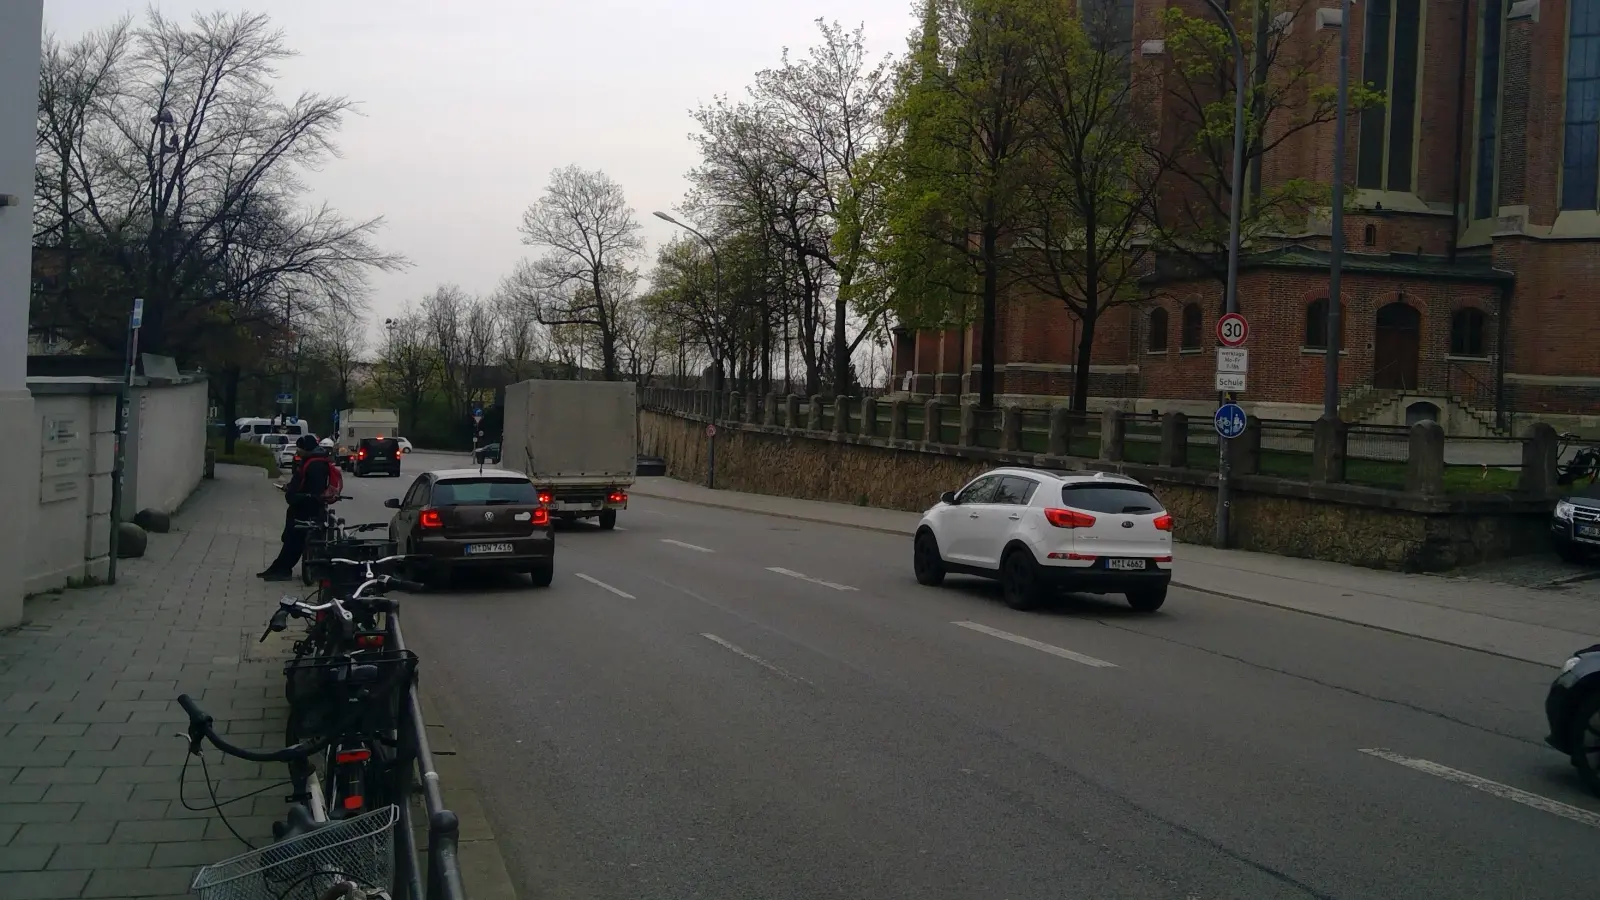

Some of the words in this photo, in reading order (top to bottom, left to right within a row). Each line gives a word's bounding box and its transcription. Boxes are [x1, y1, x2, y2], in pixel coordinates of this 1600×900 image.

[1224, 322, 1241, 338] 30
[1219, 378, 1243, 386] Schule
[1127, 560, 1143, 568] 4662
